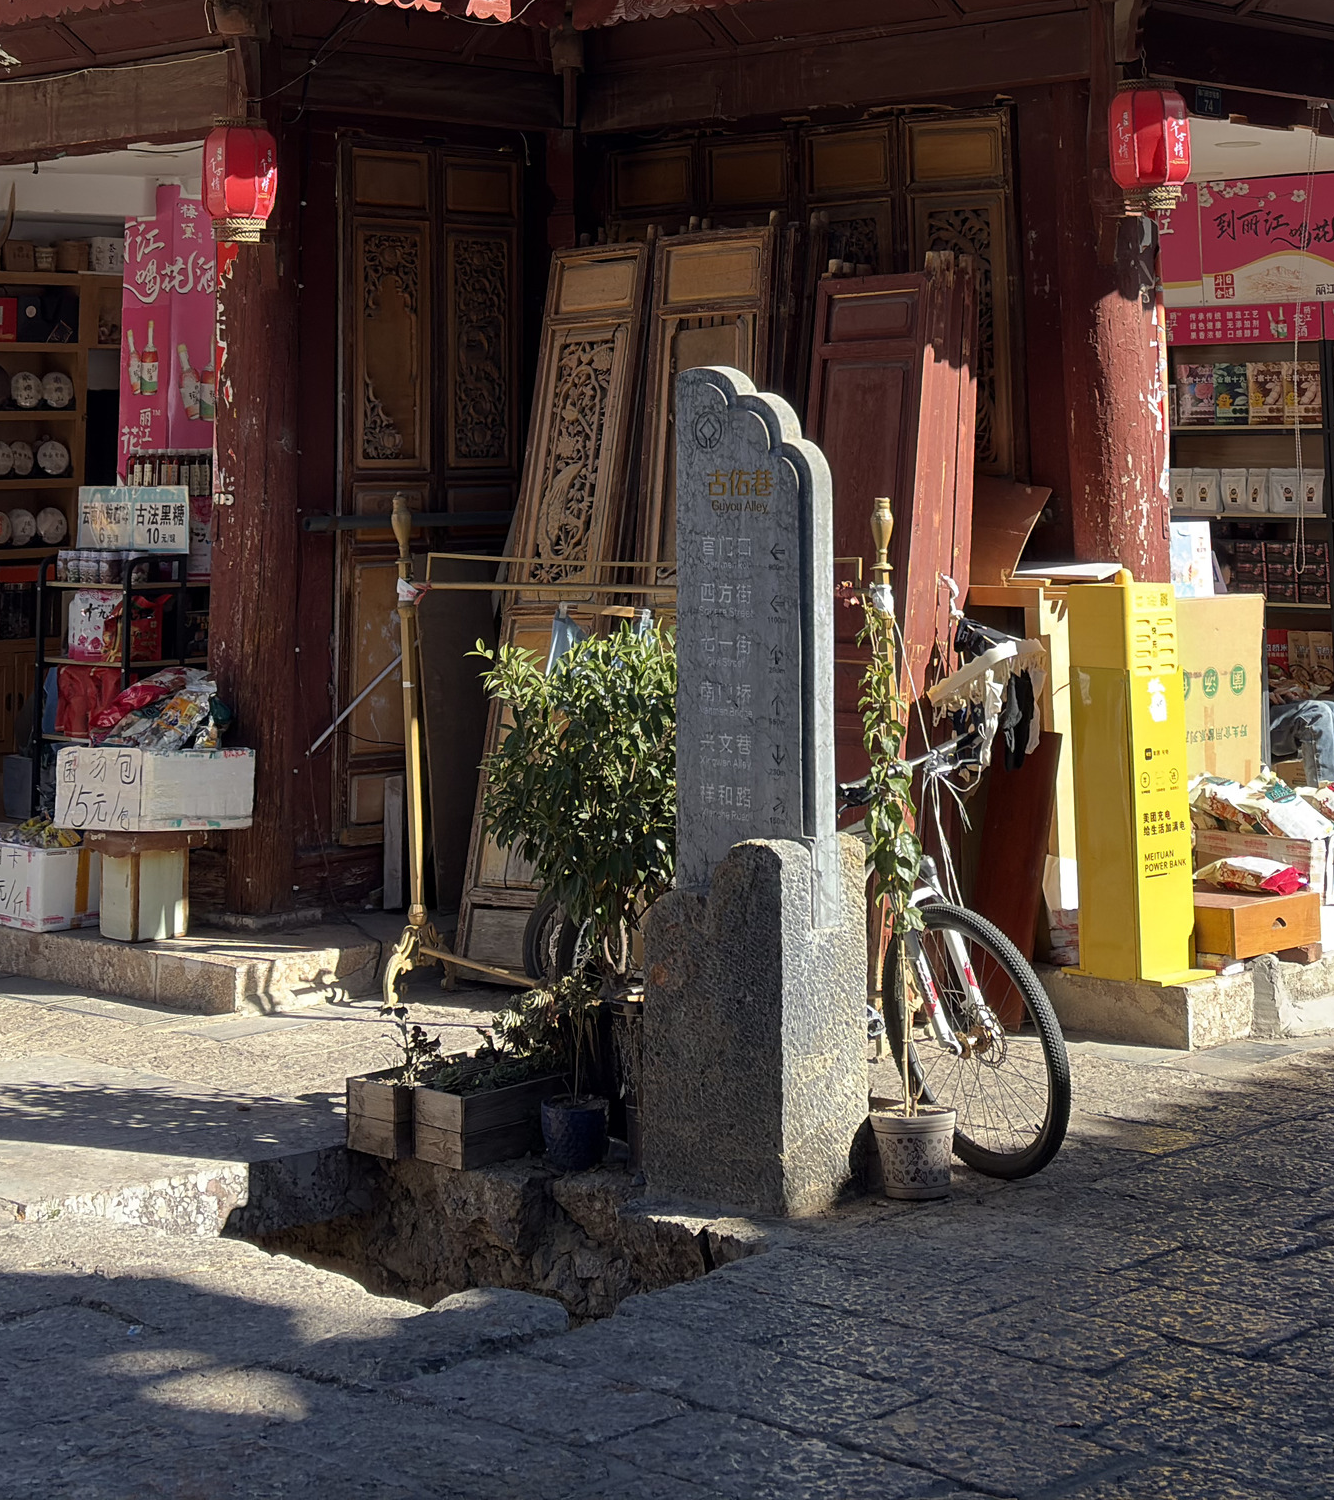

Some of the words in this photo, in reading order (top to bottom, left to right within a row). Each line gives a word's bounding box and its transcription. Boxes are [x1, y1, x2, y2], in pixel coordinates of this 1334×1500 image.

[1203, 100, 1214, 112] 74
[1115, 121, 1130, 159] 千古情
[1169, 118, 1188, 159] 千古情
[1190, 311, 1222, 321] 传承传统
[1226, 310, 1259, 319] 酿造工艺
[1190, 321, 1222, 330] 绿色健康
[1227, 320, 1259, 330] 无添加剂
[1190, 330, 1222, 340] 果香浓郁
[708, 469, 775, 497] 古佑巷
[135, 504, 185, 526] 古法黑糖
[712, 501, 742, 512] Guyou
[744, 501, 768, 513] Alley
[702, 536, 751, 557] 官门口
[700, 583, 752, 604] 四方街
[700, 634, 752, 655] 七一街
[700, 681, 752, 703] 南门桥
[700, 732, 752, 755] 兴文巷
[63, 749, 137, 785] 菌汤包
[700, 784, 751, 808] 祥和路
[63, 785, 130, 830] 15元/包
[1143, 810, 1172, 824] 美团充电
[1143, 820, 1186, 836] 给生活加满电
[1144, 849, 1175, 862] MEITUAN
[1144, 861, 1168, 873] POWER
[1169, 859, 1187, 870] BANK
